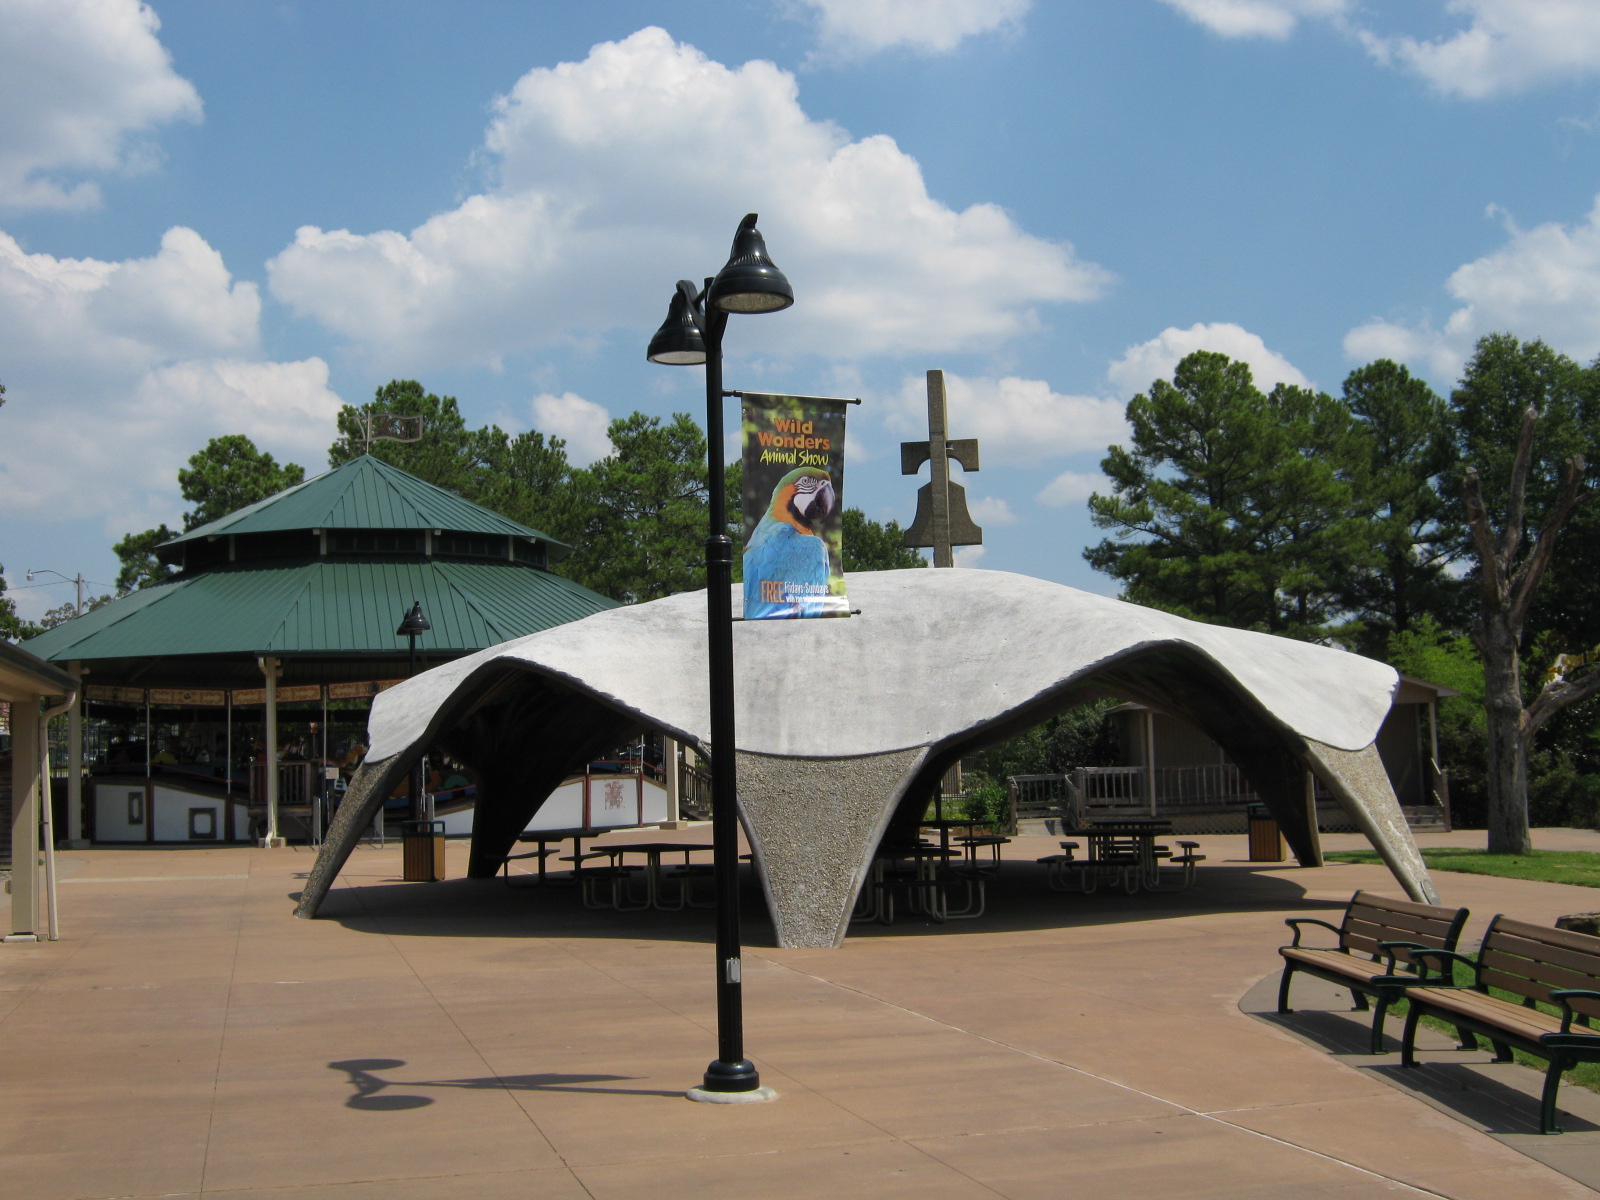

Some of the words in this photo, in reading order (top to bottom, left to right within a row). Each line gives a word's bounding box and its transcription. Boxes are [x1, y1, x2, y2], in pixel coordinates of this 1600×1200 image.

[774, 419, 813, 434] Wild
[758, 432, 830, 449] Wonders
[760, 448, 797, 466] Animal
[798, 449, 829, 466] Show
[761, 580, 785, 603] FREE
